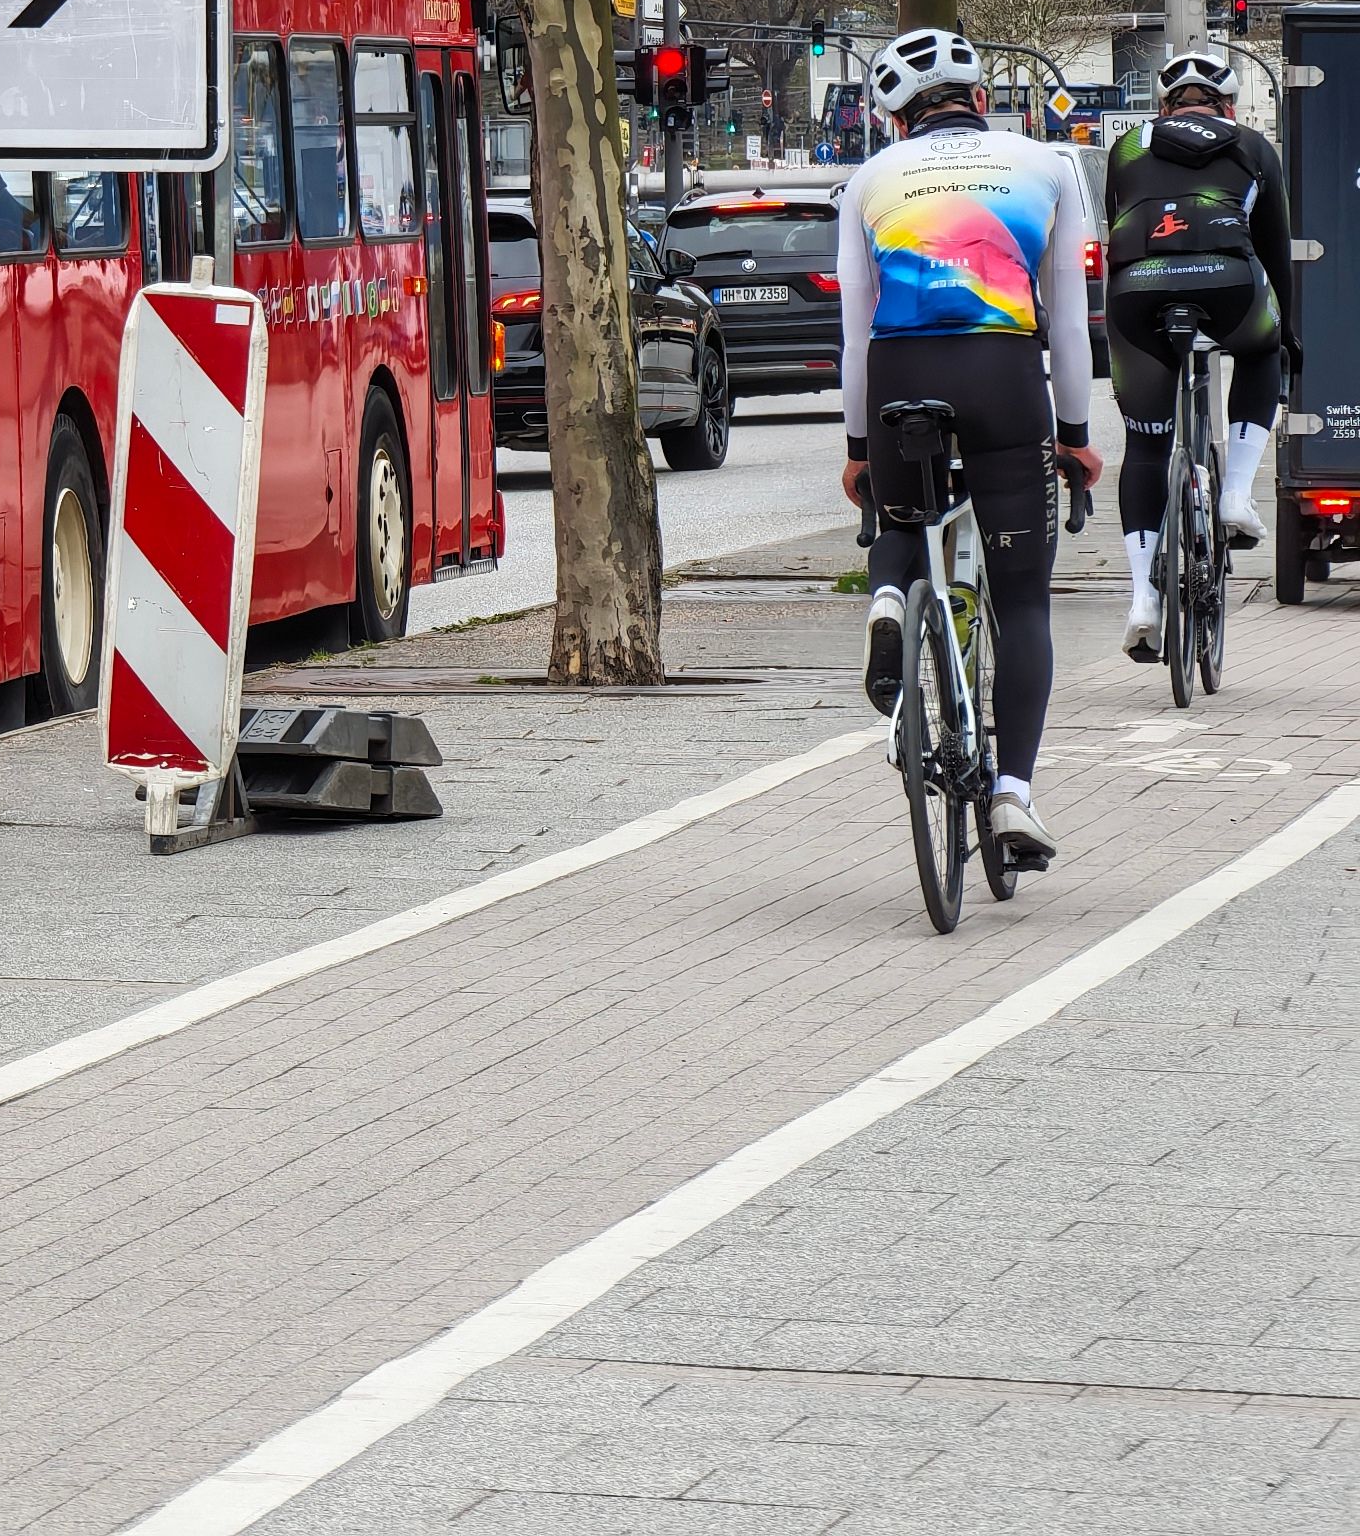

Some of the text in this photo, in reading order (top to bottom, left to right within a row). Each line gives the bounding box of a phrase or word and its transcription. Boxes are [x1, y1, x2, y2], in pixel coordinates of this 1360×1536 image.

[1112, 120, 1135, 133] City
[1164, 120, 1217, 140] HUGO
[721, 287, 787, 301] HH QX 2358
[1333, 429, 1356, 439] 2559
[1040, 434, 1057, 544] VAN RYSEL
